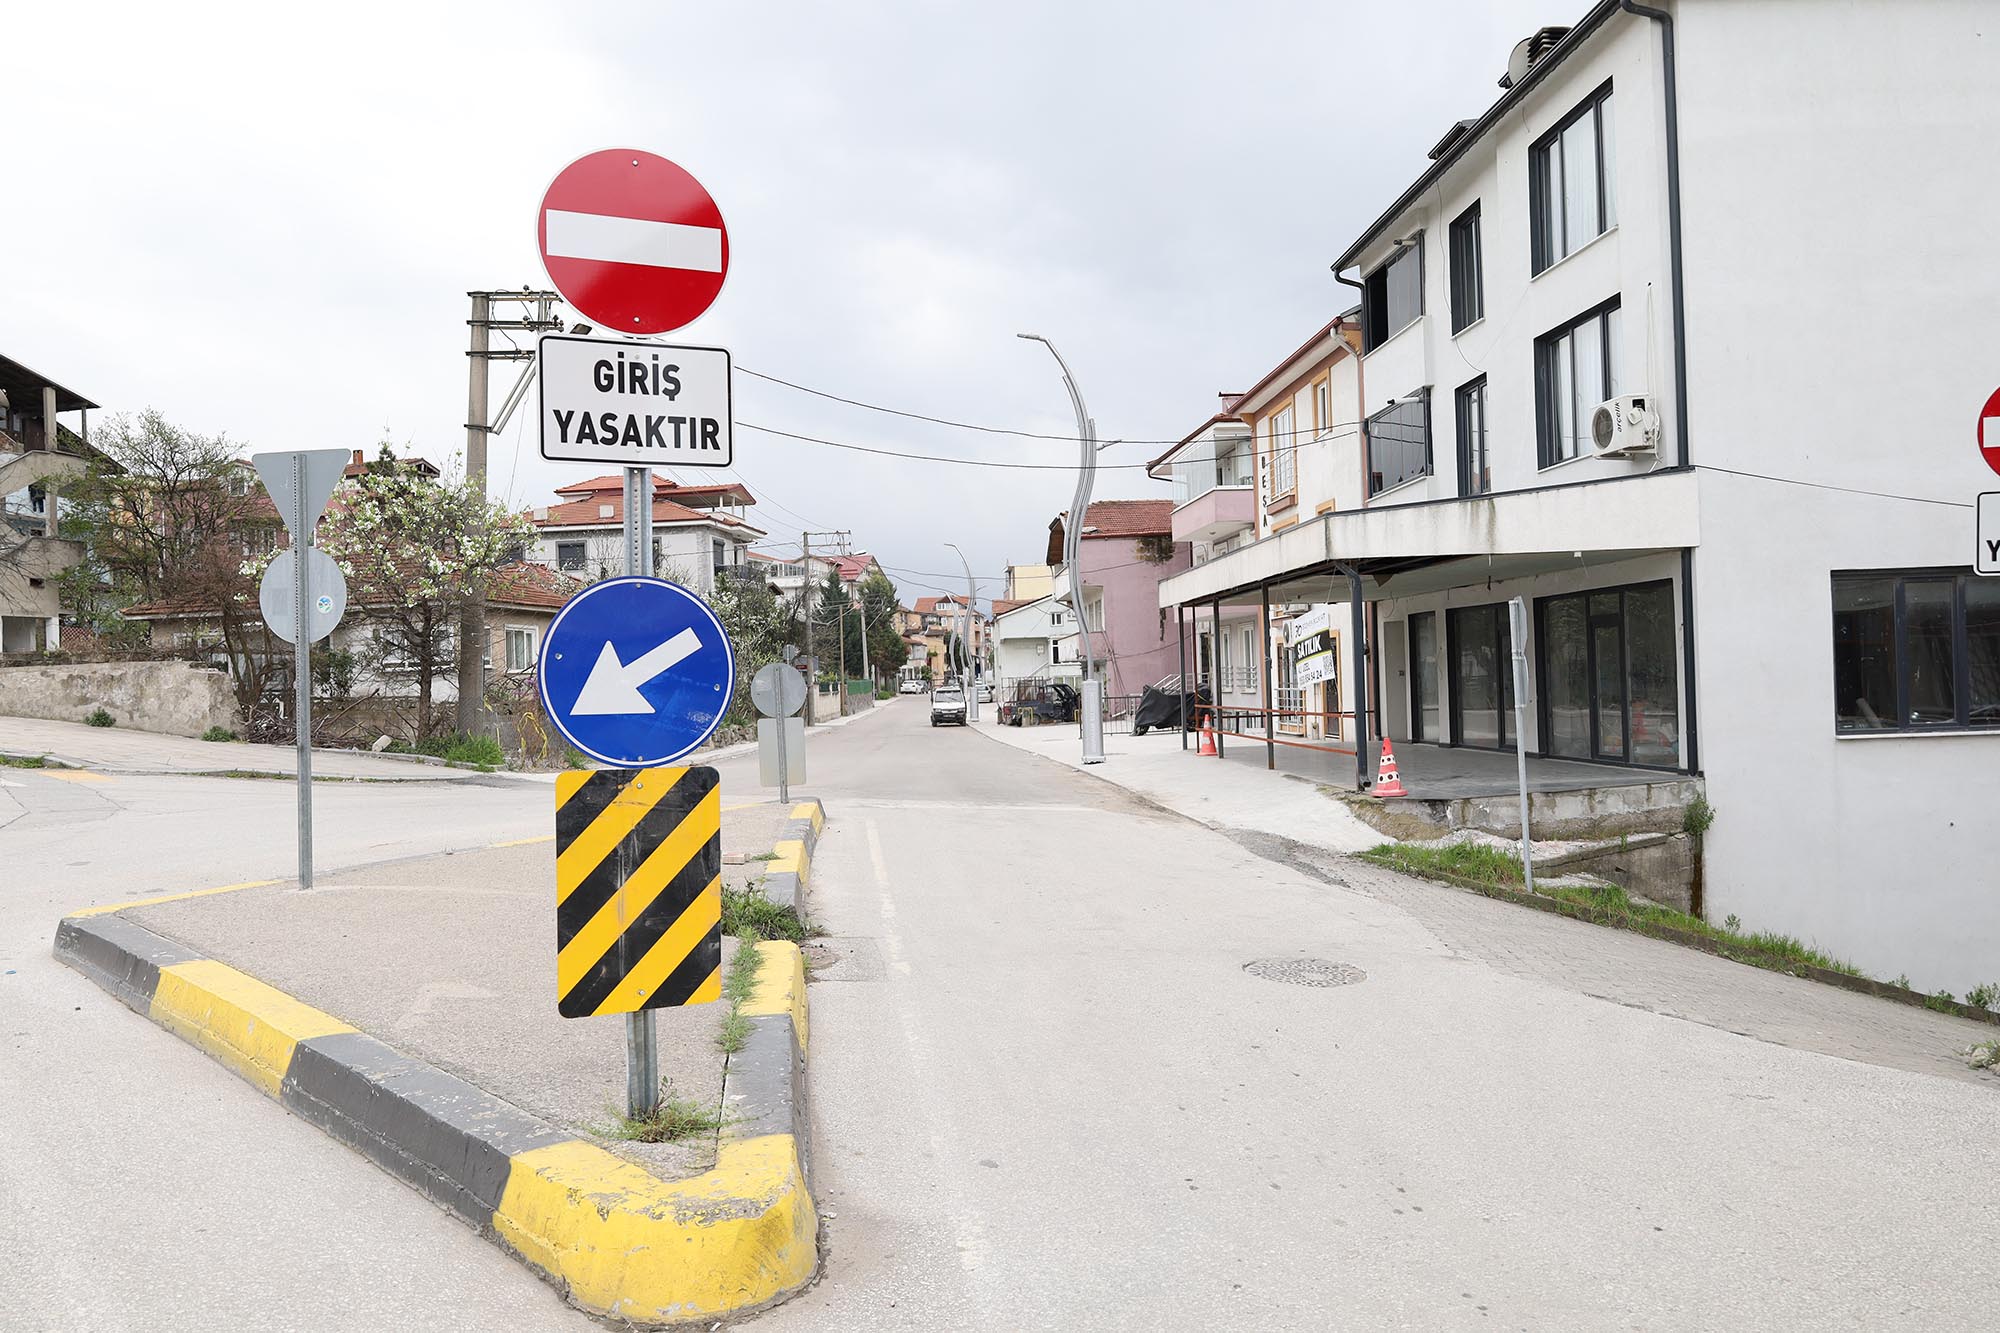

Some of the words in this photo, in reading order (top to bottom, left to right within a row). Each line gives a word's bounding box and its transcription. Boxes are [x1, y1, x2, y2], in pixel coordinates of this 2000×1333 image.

[594, 352, 681, 401] GİRİŞ
[552, 409, 721, 451] YASAKTIR
[1297, 635, 1322, 659] SATILIK
